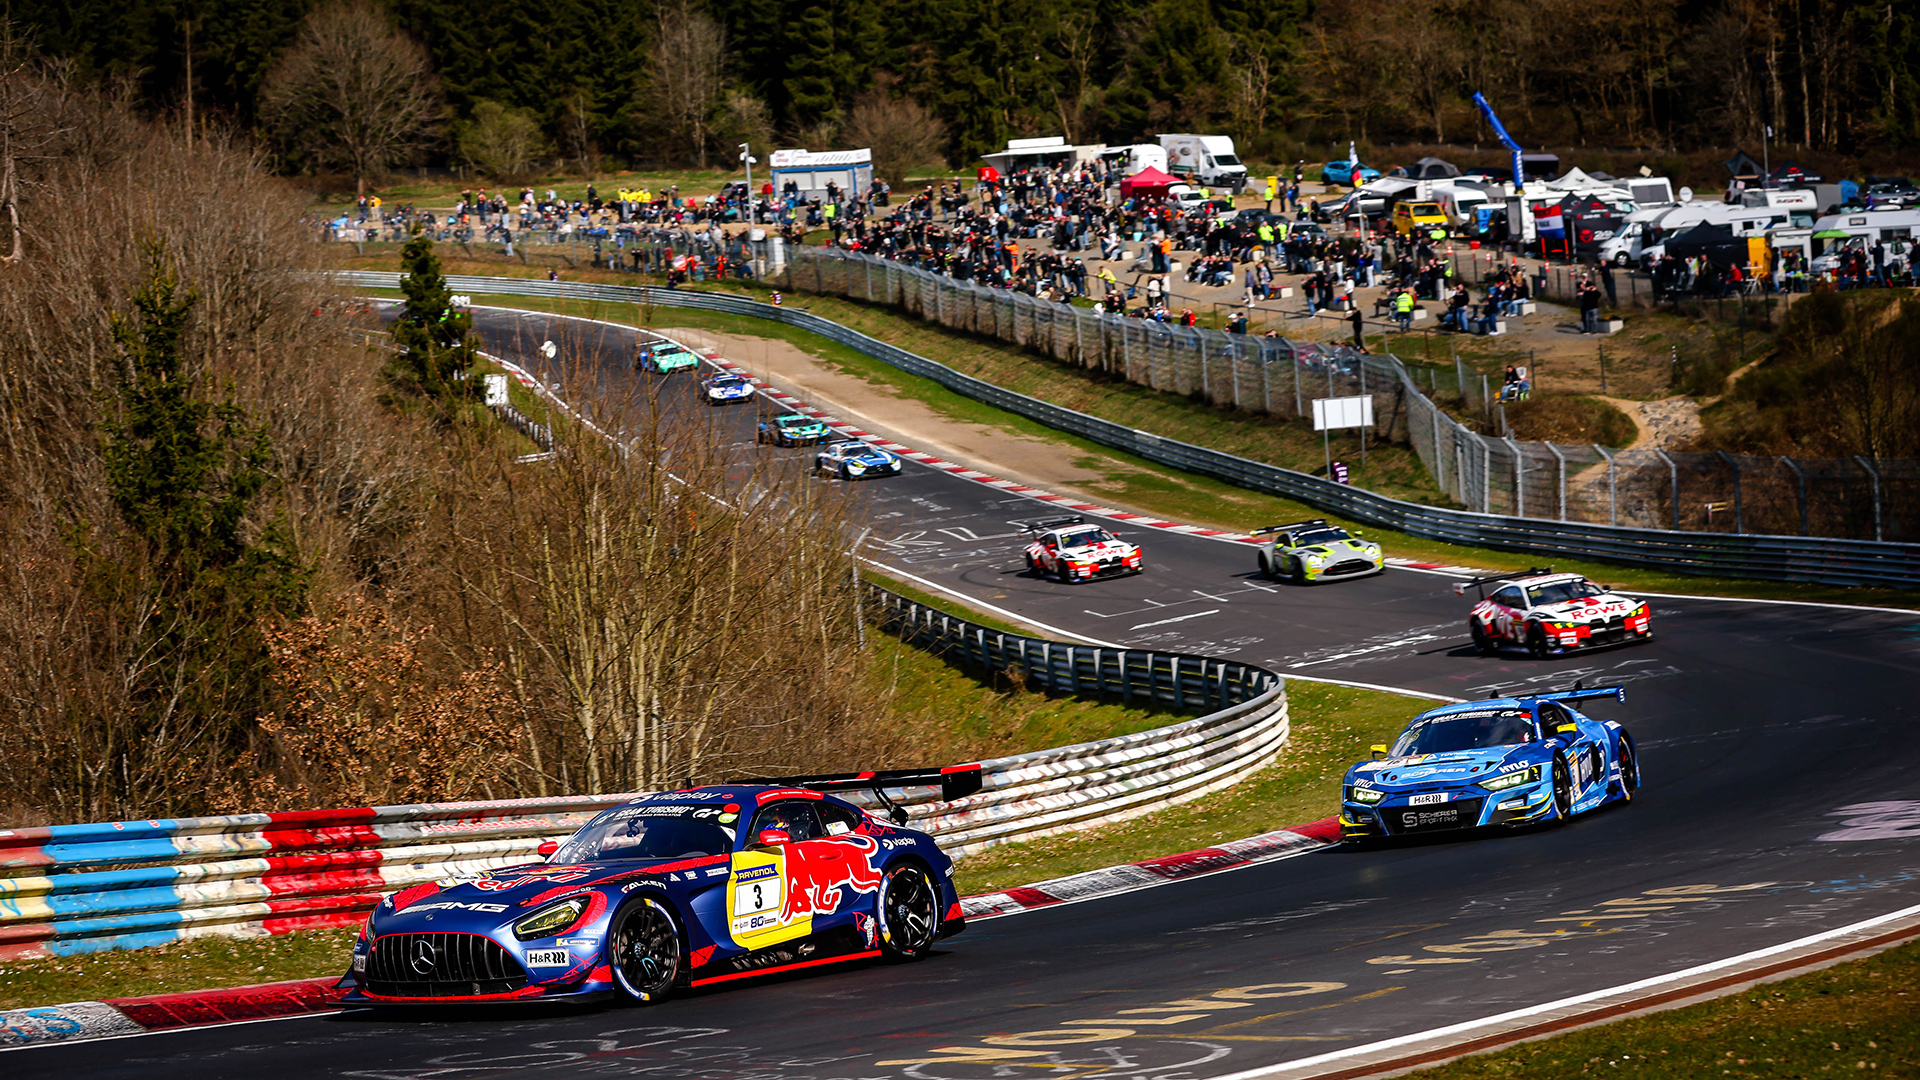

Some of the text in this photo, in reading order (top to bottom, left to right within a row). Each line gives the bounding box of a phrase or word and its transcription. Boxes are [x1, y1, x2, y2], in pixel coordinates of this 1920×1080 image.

[1087, 547, 1125, 559] ROWE
[1570, 603, 1628, 620] ROWE
[652, 792, 722, 801] viaplay
[1413, 795, 1432, 804] H&R
[1418, 809, 1458, 819] SCHERER
[891, 836, 917, 847] viaplay
[738, 867, 775, 880] RAVENOL
[621, 879, 667, 894] FALKEN
[753, 883, 763, 909] 3
[428, 902, 510, 913] AMG
[529, 952, 551, 964] H&R
[874, 982, 1348, 1067] VOLVO
